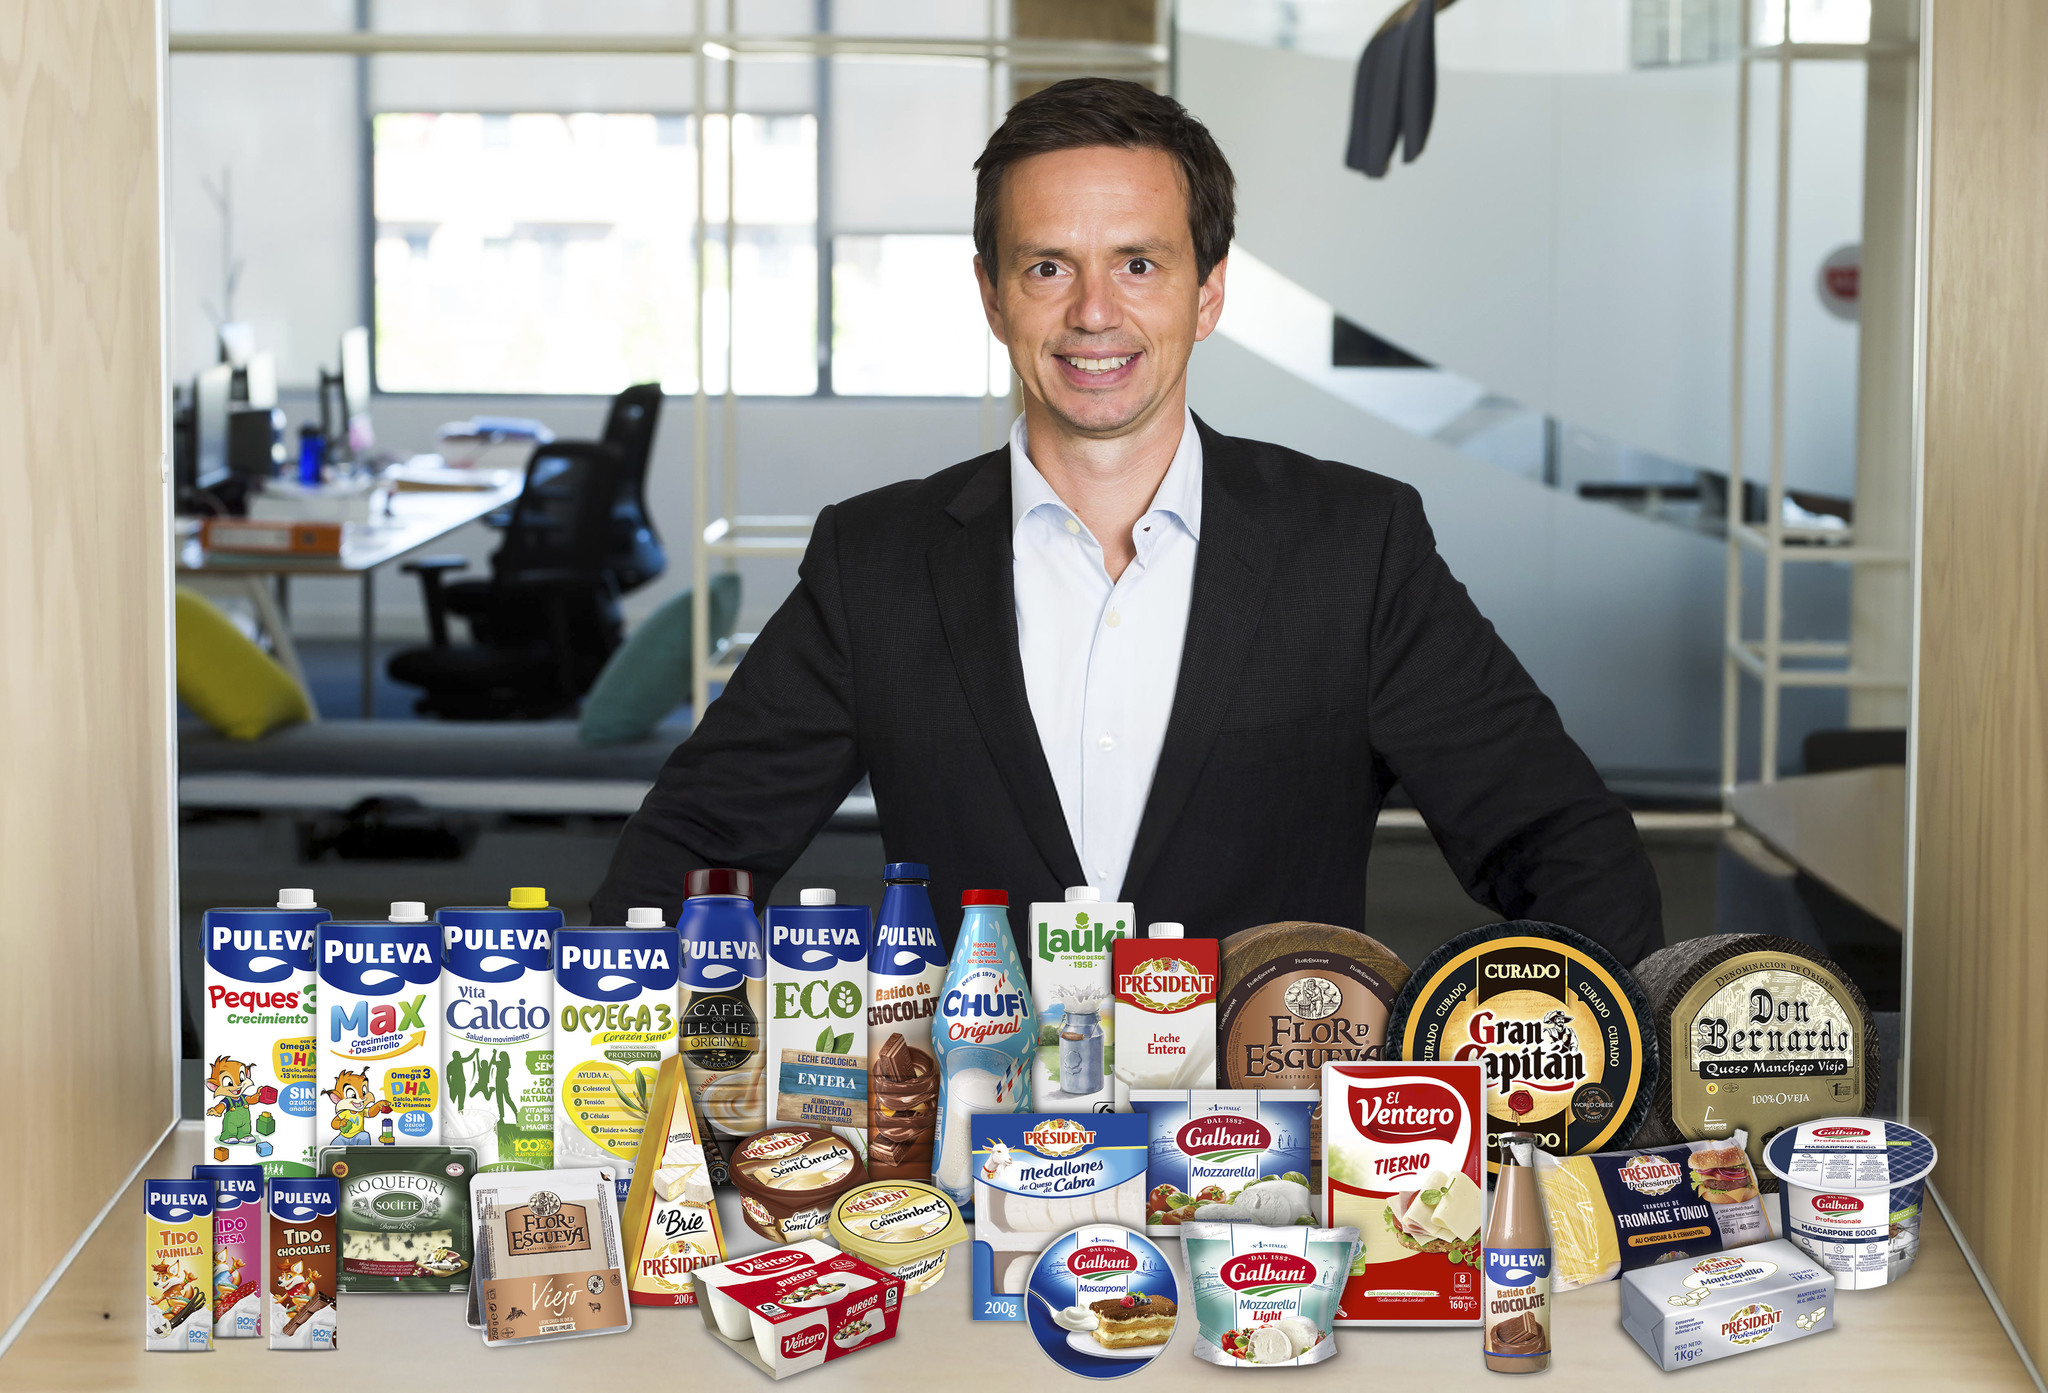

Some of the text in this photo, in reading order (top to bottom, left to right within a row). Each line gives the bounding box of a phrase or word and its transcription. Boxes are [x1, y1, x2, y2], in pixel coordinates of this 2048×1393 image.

[445, 926, 550, 950] PULEVA
[774, 926, 860, 945] PULEVA
[877, 925, 936, 947] PULEVA
[325, 940, 432, 963] PULEVA
[681, 939, 762, 960] PULEVA
[562, 946, 670, 970] PULEVA
[1485, 964, 1560, 978] CURADO
[962, 973, 980, 986] DESDE
[1121, 972, 1213, 995] PRÉSIDENT
[208, 985, 298, 1013] Peques
[458, 986, 485, 998] Vita
[876, 982, 930, 1002] Batido de
[773, 980, 862, 1019] ECO
[1436, 983, 1467, 1017] CURADO
[1579, 982, 1610, 1018] CURADO
[1750, 989, 1809, 1023] Don
[446, 999, 550, 1029] Calcio
[693, 1002, 744, 1017] CAFÉ
[227, 1014, 308, 1024] Crecimiento
[561, 1004, 672, 1032] OMEGA 3
[687, 1024, 750, 1034] LECHE
[949, 1015, 1021, 1043] Original
[1269, 1016, 1363, 1047] FLOR
[1470, 1012, 1543, 1044] Gran
[352, 1034, 403, 1047] Crecimiento
[466, 1032, 483, 1041] Salud
[493, 1033, 528, 1043] movimiento
[604, 1032, 642, 1043] Corazón
[690, 1038, 747, 1048] ORIGINAL
[1154, 1033, 1180, 1043] Leche
[1700, 1019, 1849, 1054] Bernardo
[280, 1043, 310, 1051] Omega
[356, 1042, 399, 1054] Desarrollo
[1147, 1043, 1185, 1054] Entera
[1608, 1026, 1620, 1067] CURADO
[280, 1052, 316, 1066] DHA
[798, 1054, 857, 1067] LECHE ECOLÓGICA
[423, 1069, 430, 1079] 3
[1707, 1062, 1814, 1076] Queso Manchego
[391, 1081, 430, 1095] DHA
[798, 1073, 856, 1090] ENTERA
[290, 1087, 315, 1099] SIN
[1386, 1092, 1400, 1104] El
[811, 1097, 844, 1106] ALIMENTACIÓN
[803, 1103, 852, 1116] EN LIBERTAD
[1356, 1096, 1454, 1126] Ventero
[406, 1113, 425, 1122] SIN
[827, 1116, 852, 1124] NATURALES
[669, 1133, 691, 1142] Cremoso
[1024, 1130, 1095, 1146] PRÉSIDENT
[1186, 1127, 1262, 1148] Galbani
[744, 1132, 811, 1159] PRÉSIDENT
[779, 1157, 799, 1166] Crema
[1375, 1153, 1429, 1175] TIERNO
[1020, 1160, 1103, 1181] Medallones
[1192, 1167, 1255, 1177] Mozzarella
[1619, 1161, 1682, 1182] PRÉSIDENT
[347, 1176, 449, 1196] ROQUEFORT
[1029, 1181, 1052, 1190] Queso
[1054, 1177, 1095, 1192] Cabra
[1629, 1177, 1680, 1190] Professionnel
[151, 1192, 207, 1205] PULEVA
[274, 1191, 331, 1204] PULEVA
[846, 1189, 909, 1213] PRÉSIDENT
[1816, 1199, 1858, 1210] Galbani
[793, 1212, 811, 1222] Crema
[870, 1200, 945, 1231] Camembert
[881, 1212, 900, 1220] Crema
[1617, 1209, 1673, 1228] FROMAGE
[1676, 1205, 1709, 1222] FONDU
[1816, 1216, 1861, 1224] Professionale
[213, 1218, 247, 1232] TIDO
[523, 1214, 571, 1232] FLOR
[656, 1209, 703, 1237] le Brie
[283, 1229, 322, 1245] TIDO
[1802, 1224, 1853, 1237] MASCARPONE
[160, 1230, 198, 1246] TIDO
[213, 1234, 244, 1245] FRESA
[511, 1227, 585, 1250] ESGUEVA
[1643, 1235, 1667, 1243] CHEDDAR
[156, 1246, 203, 1259] VAINILLA
[277, 1245, 331, 1257] CHOCOLATE
[736, 1252, 804, 1271] Ventero
[1074, 1254, 1130, 1269] Galbani
[1491, 1253, 1545, 1267] PULEVA
[1693, 1258, 1745, 1273] PRÉSIDENT
[776, 1269, 818, 1286] BURGOS
[1230, 1263, 1306, 1282] Galbani
[1460, 1275, 1465, 1283] 8
[1700, 1267, 1764, 1287] Mantequilla
[1079, 1285, 1126, 1294] Mascarpone
[1497, 1286, 1536, 1299] Batido de
[1797, 1288, 1827, 1298] MANTEQUILLA
[532, 1278, 583, 1317] Viejo
[1491, 1294, 1545, 1314] CHOCOLATE
[846, 1294, 878, 1316] BURGOS
[985, 1302, 1017, 1316] 200g
[1240, 1300, 1296, 1310] Mozzarella
[237, 1317, 255, 1326] 90%
[1253, 1311, 1281, 1322] Light
[1722, 1310, 1782, 1335] PRÉSIDENT
[189, 1330, 208, 1339] 90%
[313, 1329, 331, 1338] 90%
[1729, 1325, 1773, 1341] Profesional
[784, 1332, 825, 1353] Ventero
